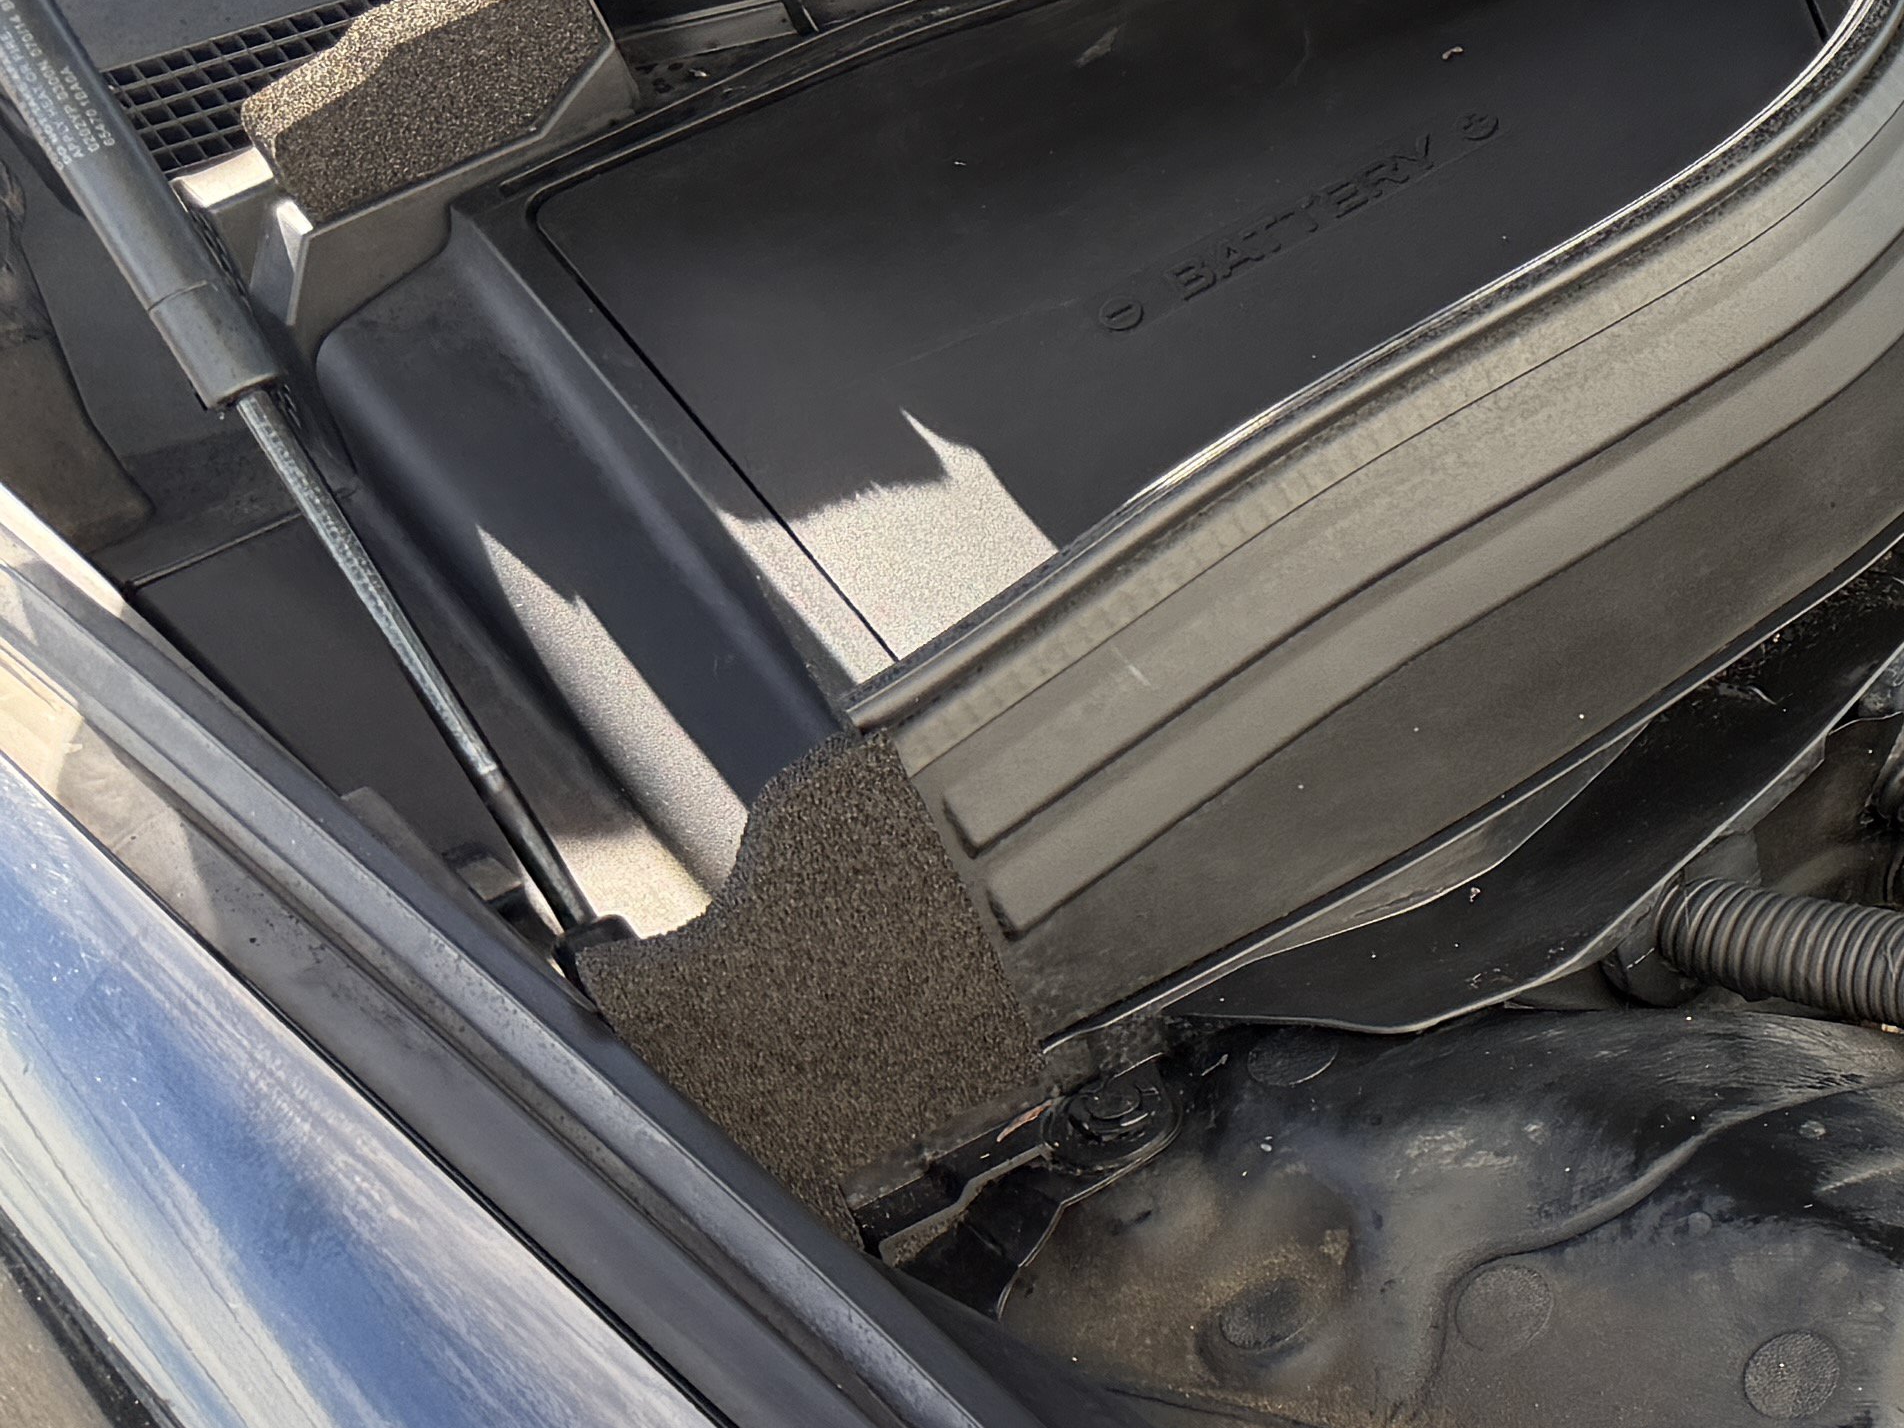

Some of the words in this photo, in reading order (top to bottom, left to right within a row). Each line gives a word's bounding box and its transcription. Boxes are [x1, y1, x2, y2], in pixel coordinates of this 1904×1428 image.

[32, 83, 57, 117] HEAT
[55, 119, 85, 158] APPLY
[1167, 133, 1435, 301] BATTERY
